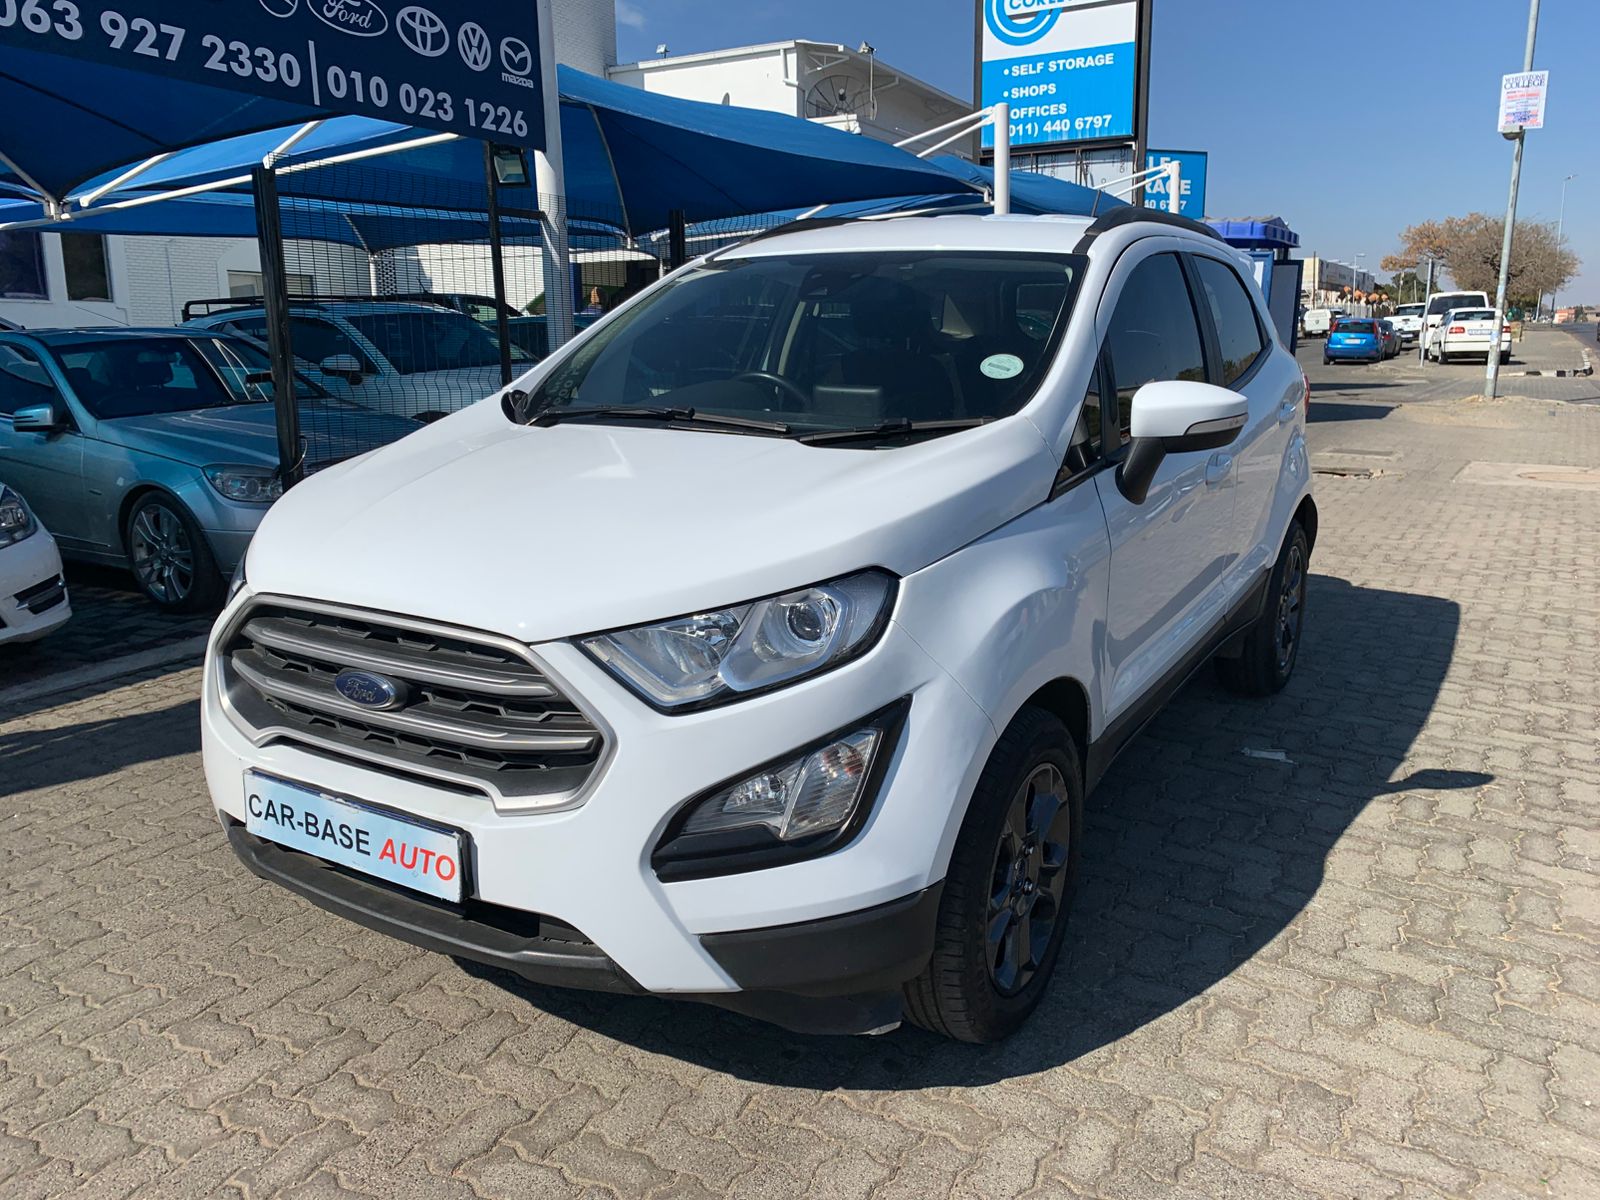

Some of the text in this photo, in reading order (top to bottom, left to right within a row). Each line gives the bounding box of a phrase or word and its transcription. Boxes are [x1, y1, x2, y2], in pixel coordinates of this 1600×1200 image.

[323, 0, 373, 28] Ford
[100, 10, 186, 61] 927
[201, 34, 300, 87] 2330
[327, 65, 389, 107] 010
[399, 83, 454, 121] 023
[464, 98, 528, 137] 1226
[1011, 53, 1115, 77] SELF STORAGE
[501, 72, 534, 89] mazda
[1011, 83, 1057, 99] SHOPS
[1504, 79, 1545, 90] COLLEGE
[1010, 103, 1067, 120] OFFICES
[1043, 118, 1071, 133] 440
[1074, 114, 1113, 130] 6797
[344, 677, 377, 702] Ford
[248, 793, 456, 882] CAR-BASE AUTO
